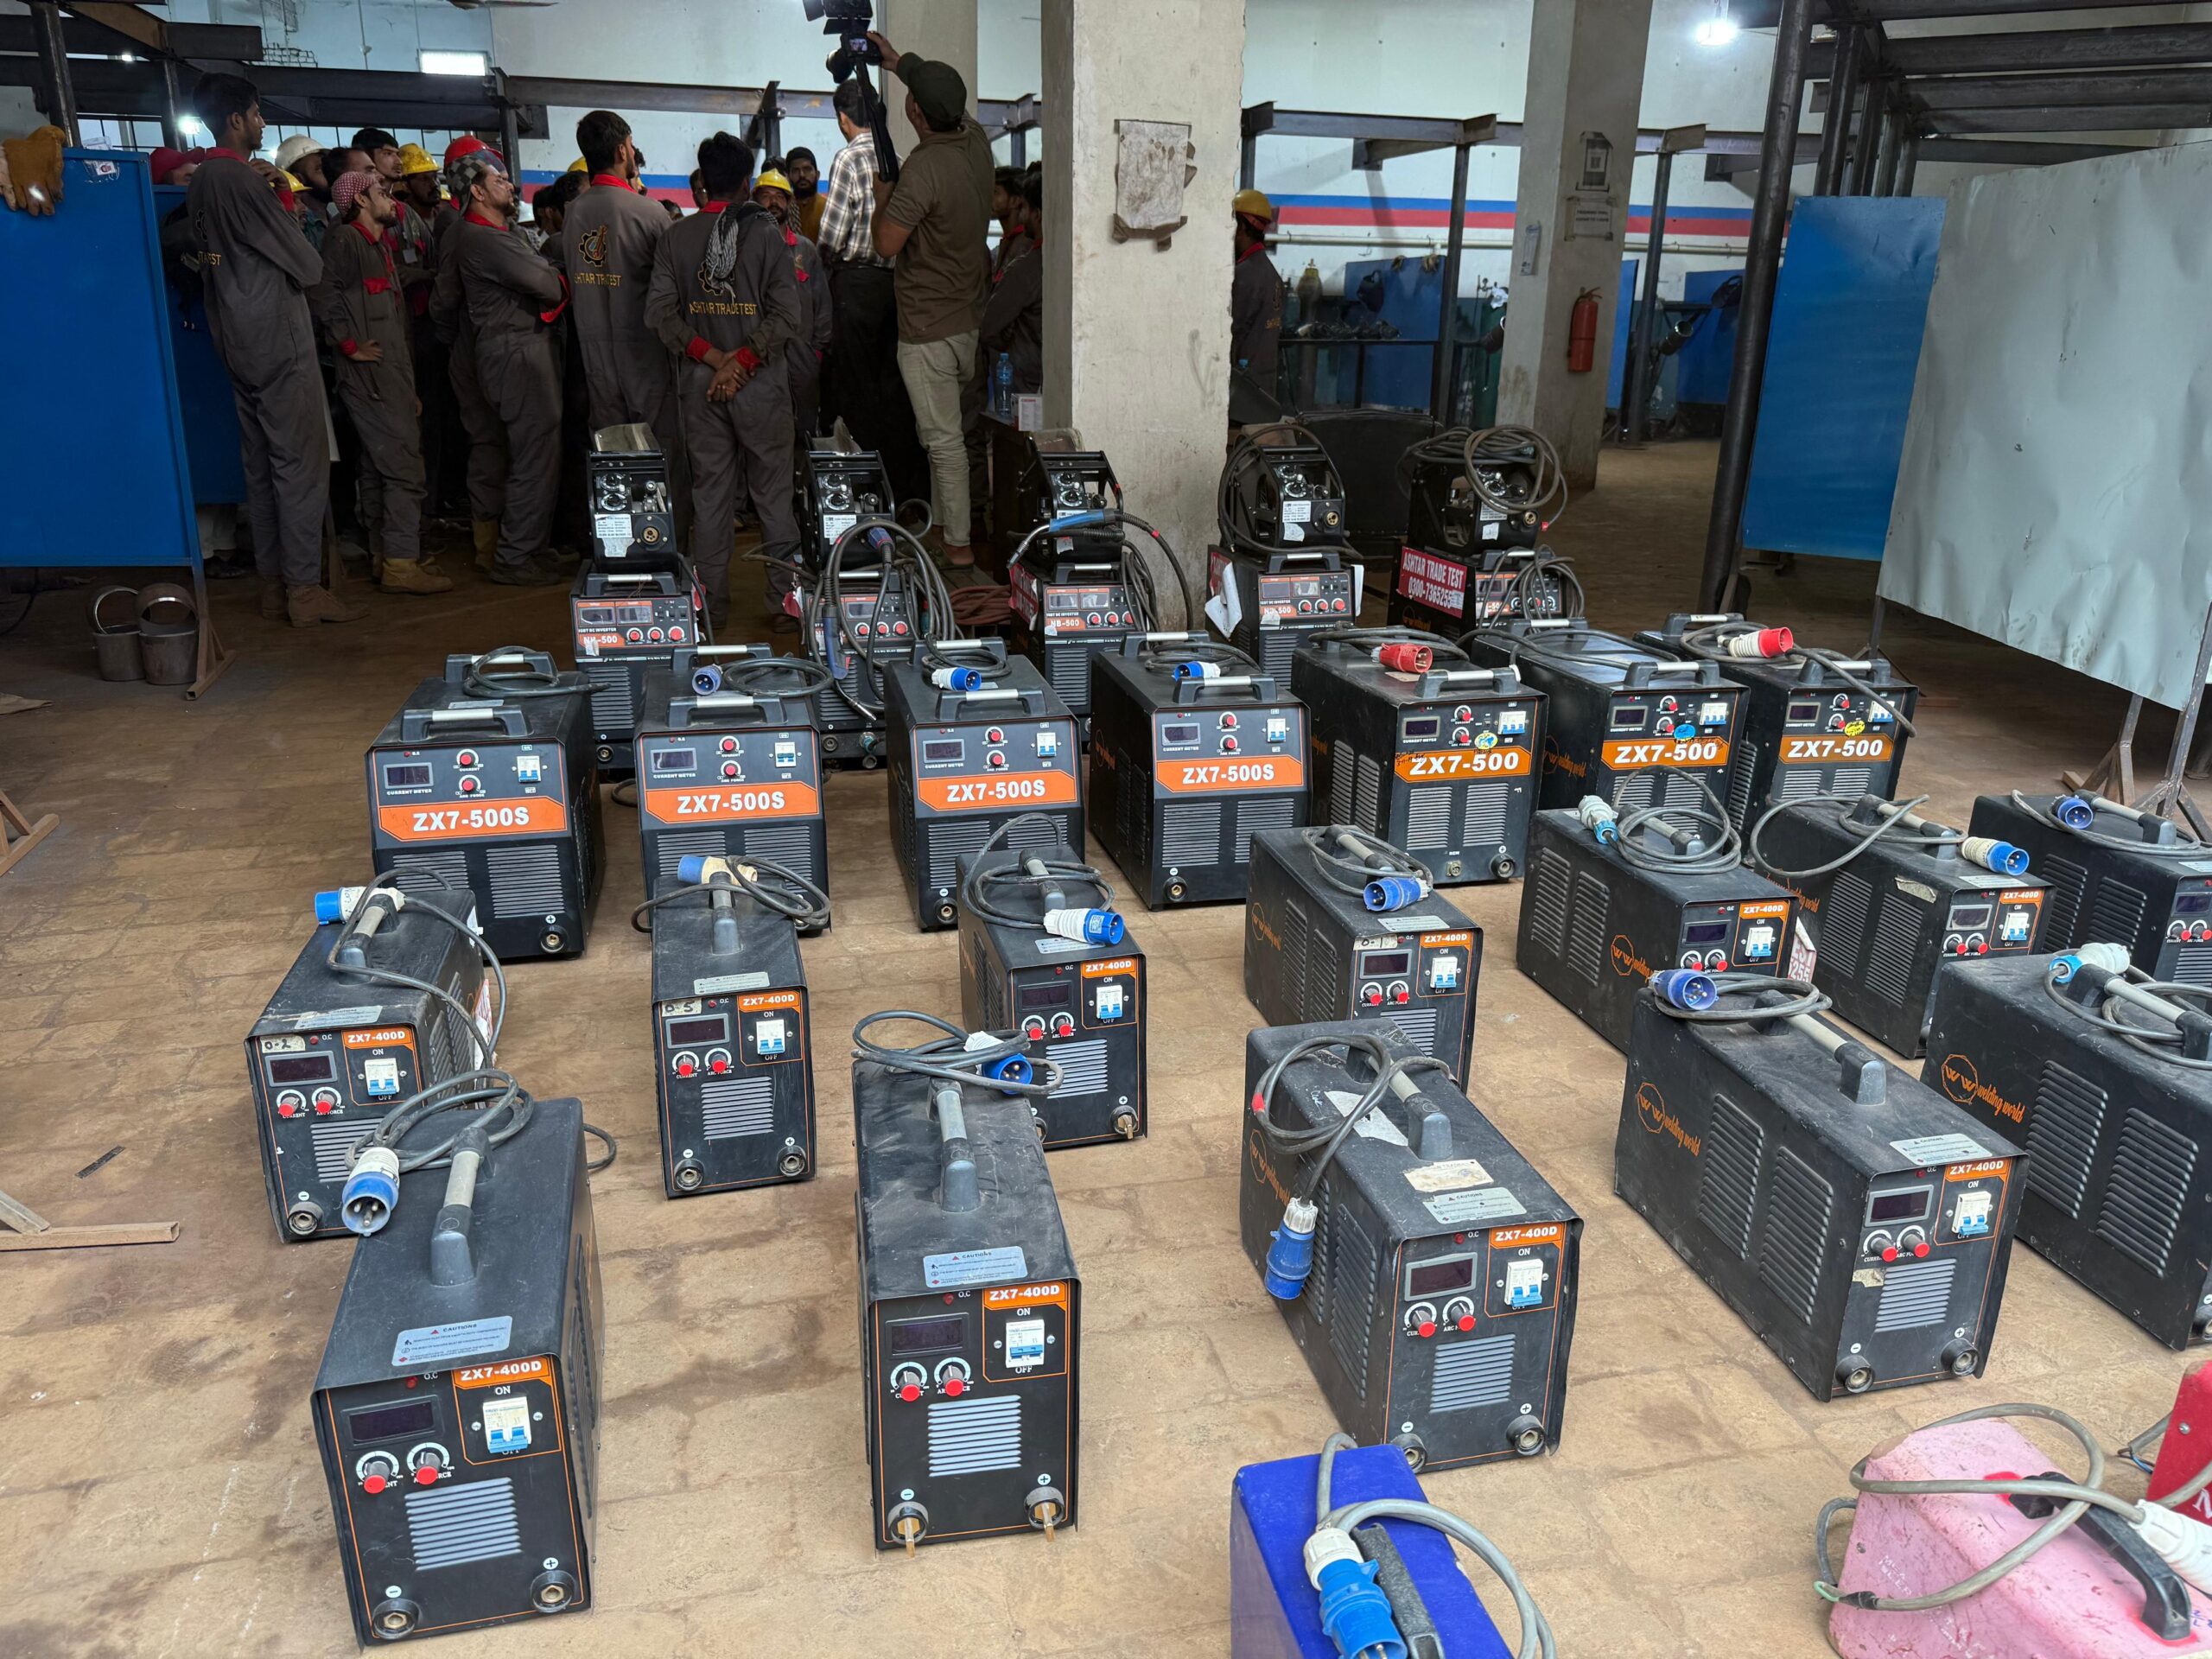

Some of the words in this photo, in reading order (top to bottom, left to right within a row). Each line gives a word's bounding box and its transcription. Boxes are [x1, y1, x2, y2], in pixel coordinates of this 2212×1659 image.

[1402, 552, 1426, 577] ASHTAR
[1427, 560, 1448, 584] TRADE
[1447, 566, 1464, 589] TEST
[1051, 619, 1079, 628] NB-500
[1614, 741, 1718, 764] ZX7-500
[1787, 739, 1884, 759] ZX7-500
[1409, 752, 1519, 776] ZX7-500
[1182, 763, 1274, 785] ZX7-500S
[947, 779, 1046, 803] ZX7-500S
[677, 791, 785, 814] ZX7-500S
[412, 806, 530, 832] ZX7-500S
[1744, 905, 1783, 914] ZX7-400D
[1424, 933, 1468, 943] ZX7-400D
[1085, 961, 1132, 972] ZX7-400D
[742, 995, 795, 1007] ZX7-400D
[264, 1039, 291, 1049] 0-2
[347, 1031, 405, 1044] ZX7-400D
[1976, 1083, 2004, 1116] welding
[2002, 1102, 2025, 1124] world
[1949, 1160, 2004, 1175] ZX7-400D
[1967, 1180, 1980, 1189] ON
[1495, 1226, 1558, 1242] ZX7-400D
[1518, 1248, 1530, 1256] ON
[989, 1285, 1060, 1301] ZX7-400D
[1016, 1307, 1031, 1316] ON
[442, 1324, 477, 1332] CAUTIONS
[460, 1361, 542, 1382] ZX7-400D
[1015, 1365, 1033, 1374] OFF
[494, 1386, 511, 1395] ON
